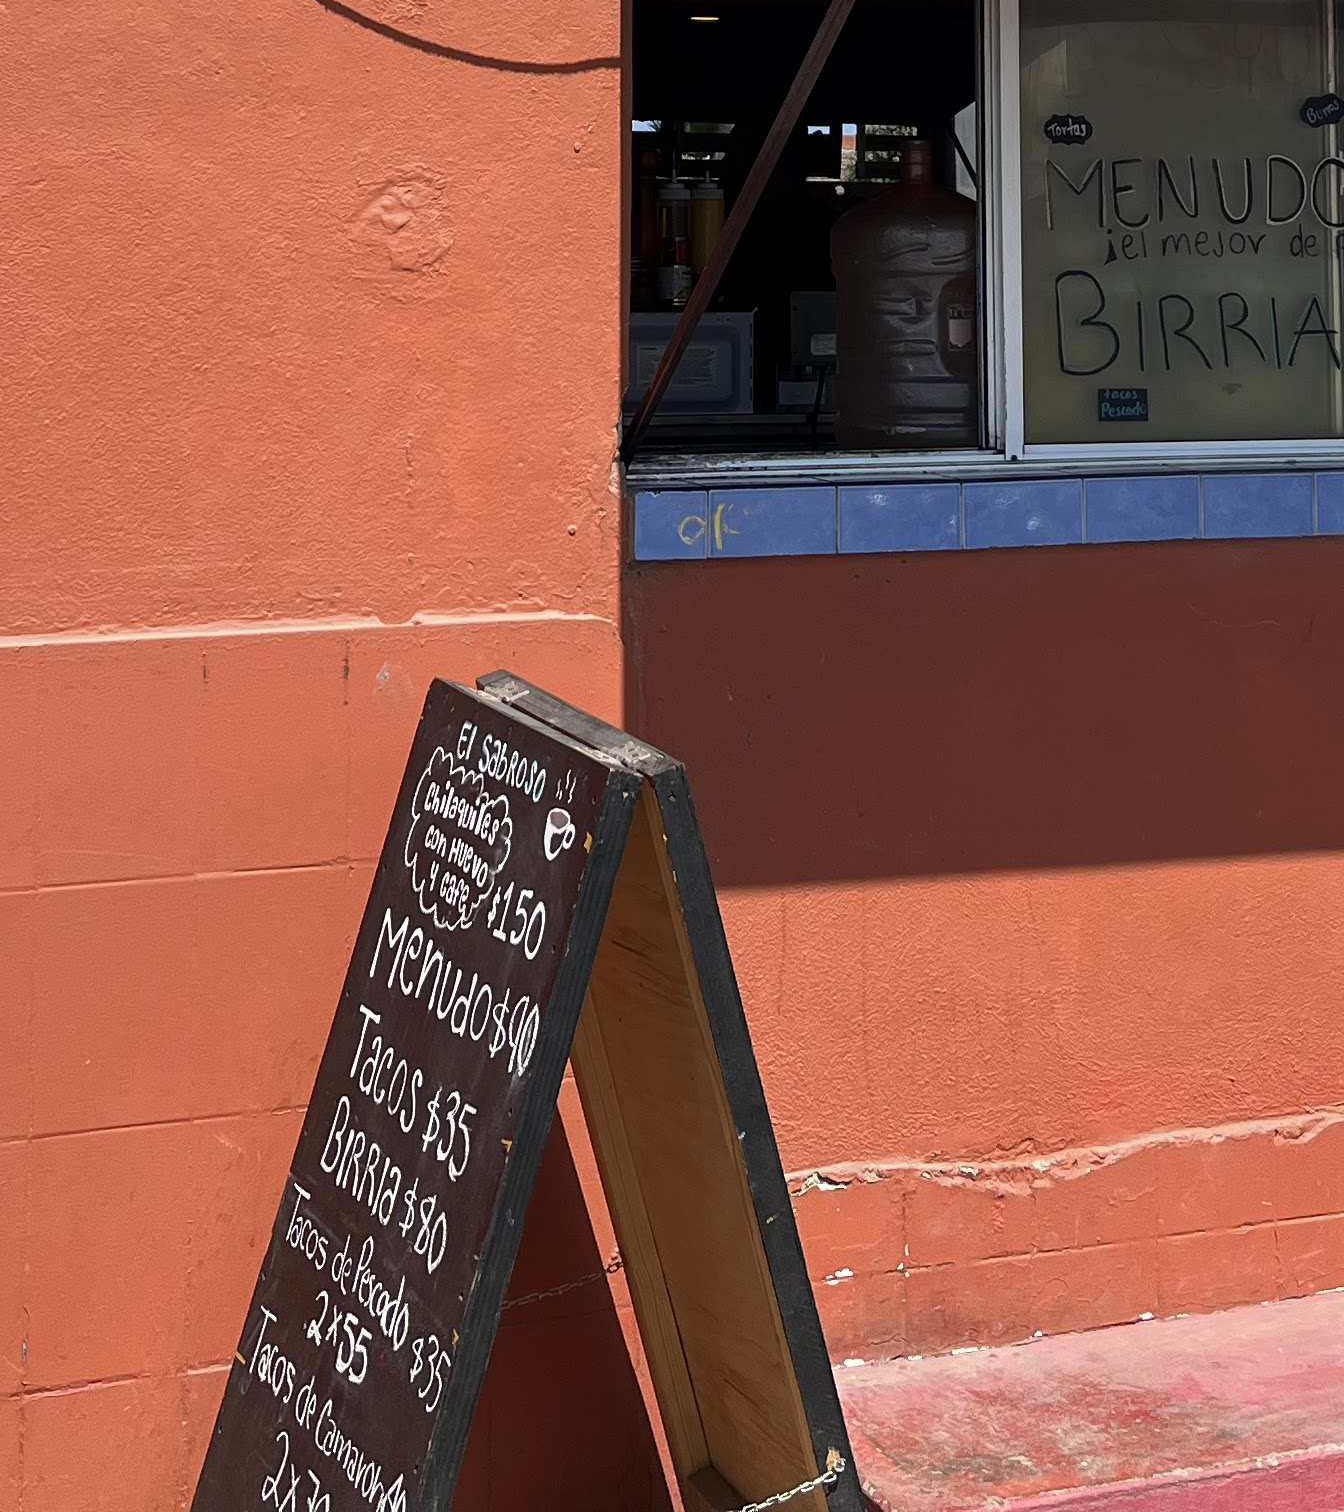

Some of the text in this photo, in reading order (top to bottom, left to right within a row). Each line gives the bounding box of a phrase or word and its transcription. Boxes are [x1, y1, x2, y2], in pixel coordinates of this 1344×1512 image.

[1046, 117, 1088, 137] Tortas
[1289, 224, 1319, 258] de
[1055, 269, 1342, 376] BIRRIA
[456, 720, 478, 761] El
[424, 824, 447, 858] con
[487, 880, 547, 961] $150
[369, 907, 493, 1042] Menudo
[349, 1003, 478, 1183] Tacos $35
[398, 1176, 448, 1275] $80
[285, 1182, 452, 1413] Tacos de Pescado $35
[306, 1290, 373, 1385] 2x55
[249, 1305, 297, 1405] Tacos
[295, 1374, 318, 1430] de
